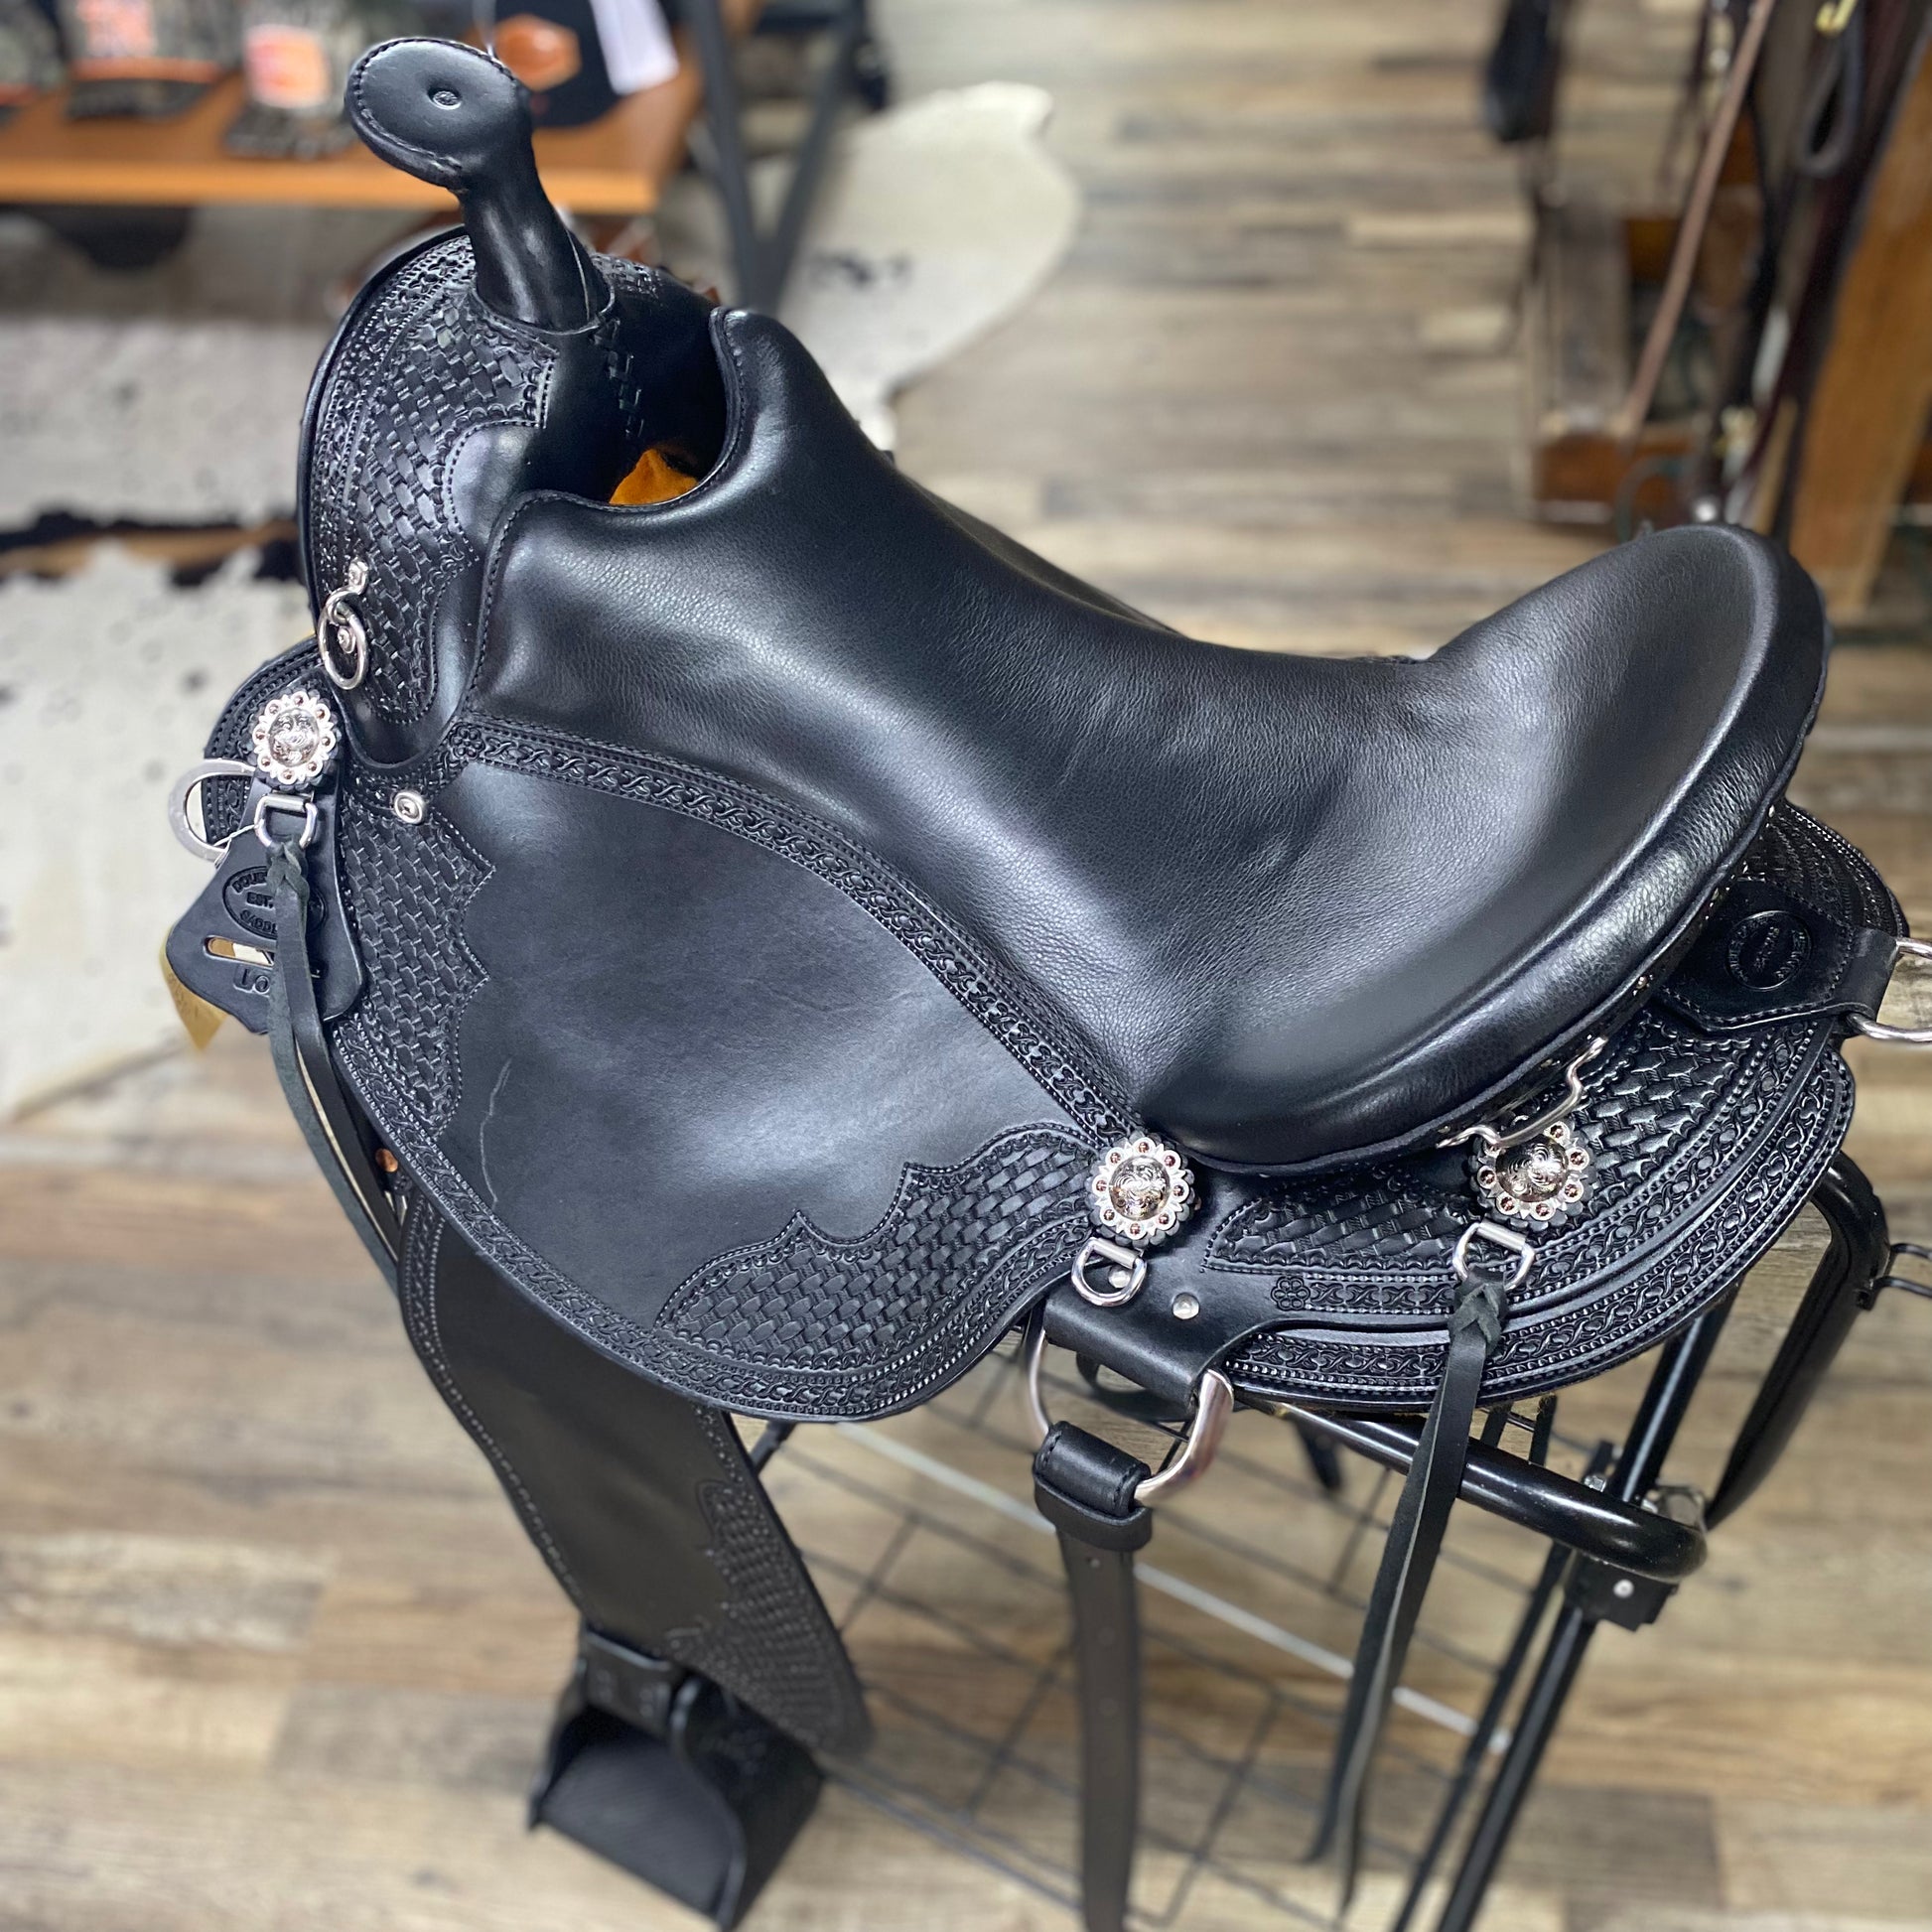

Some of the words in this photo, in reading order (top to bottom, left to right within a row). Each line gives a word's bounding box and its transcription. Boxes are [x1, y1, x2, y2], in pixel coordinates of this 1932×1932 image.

[231, 872, 267, 893] DOUB
[246, 892, 274, 908] EST.
[240, 909, 278, 934] SADDL
